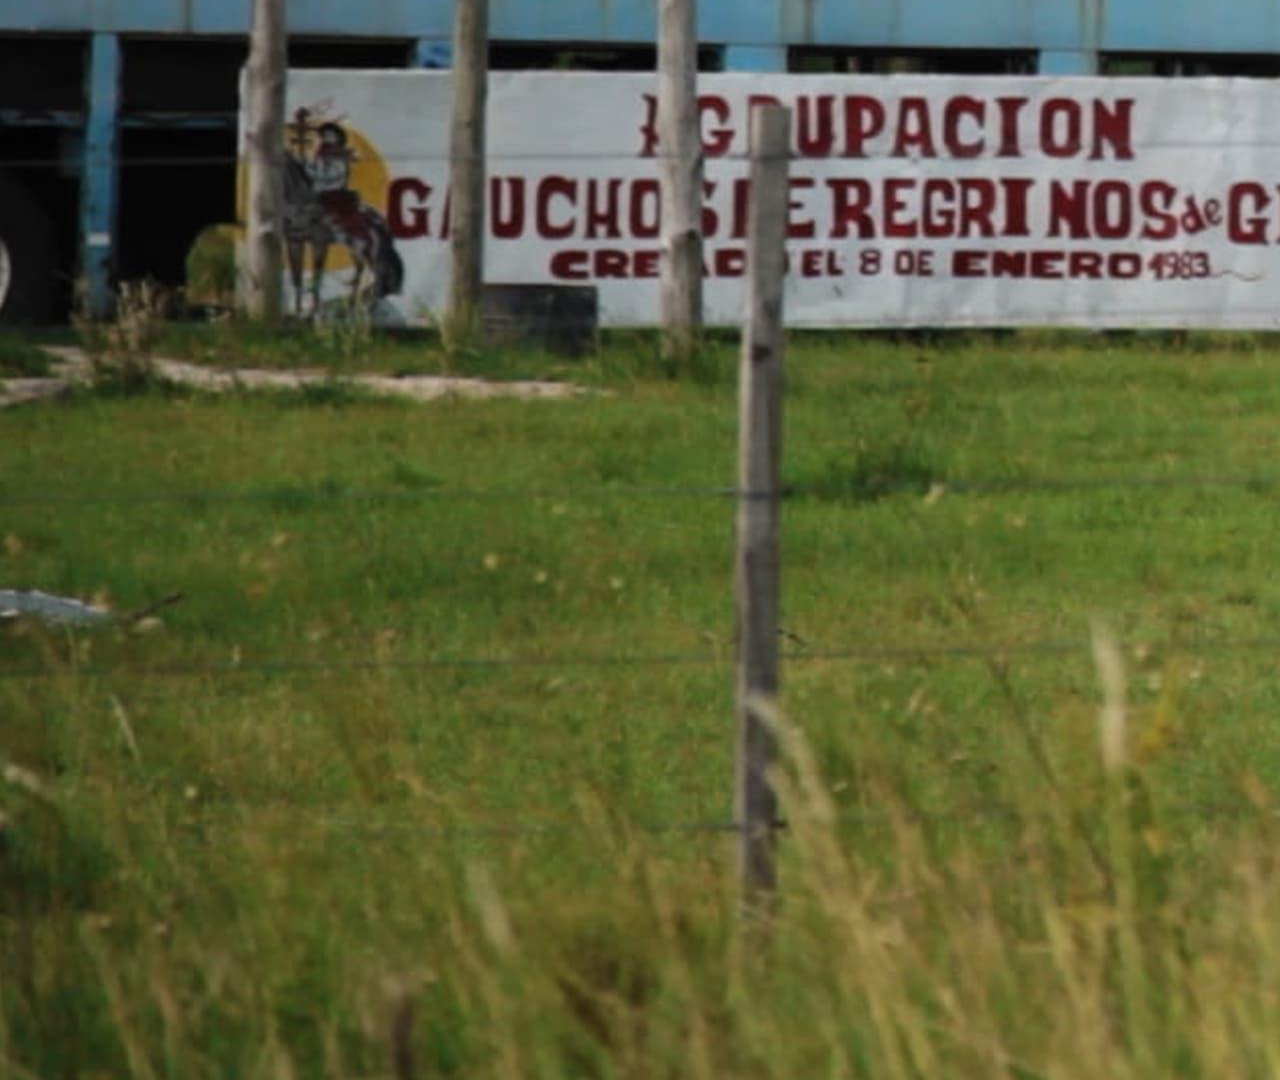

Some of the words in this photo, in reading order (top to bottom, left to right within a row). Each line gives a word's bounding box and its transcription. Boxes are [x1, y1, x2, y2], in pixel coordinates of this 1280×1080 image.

[639, 94, 1135, 160] GUPACION
[386, 176, 719, 240] GUCHO
[1181, 194, 1222, 234] de
[550, 249, 789, 279] CRED
[802, 251, 844, 278] EL
[859, 249, 882, 276] 8
[894, 250, 934, 277] DE
[951, 251, 1142, 279] ENERO
[1147, 251, 1212, 281] 1983
